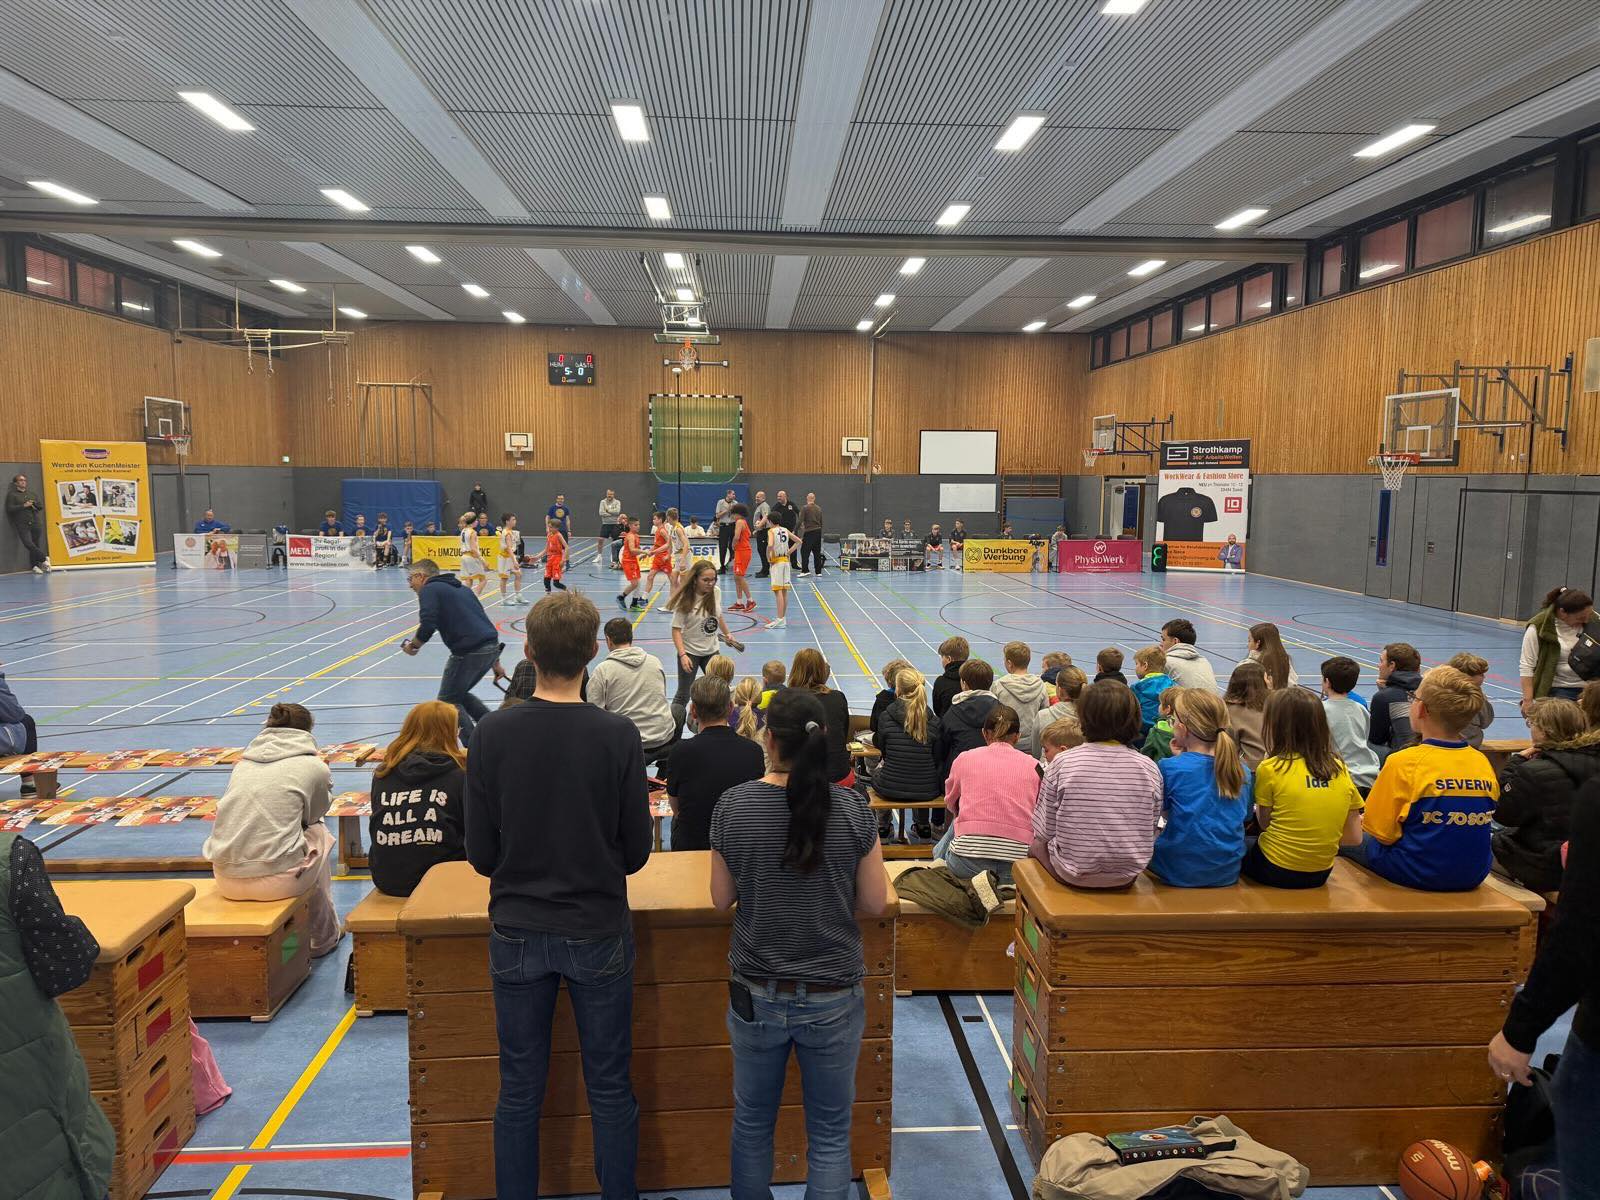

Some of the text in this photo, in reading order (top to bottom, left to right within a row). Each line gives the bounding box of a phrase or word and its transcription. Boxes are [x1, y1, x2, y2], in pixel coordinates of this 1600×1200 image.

[1193, 446, 1243, 455] Strothkamp
[777, 531, 787, 543] 15
[983, 554, 1026, 562] Werbung
[1074, 555, 1125, 564] PhysioWerk
[1305, 775, 1330, 789] Ida
[1435, 779, 1492, 792] SEVERIN
[381, 789, 448, 807] LIFE IS
[382, 808, 437, 826] ALL A
[1446, 811, 1467, 825] 70
[376, 827, 443, 846] DREAM
